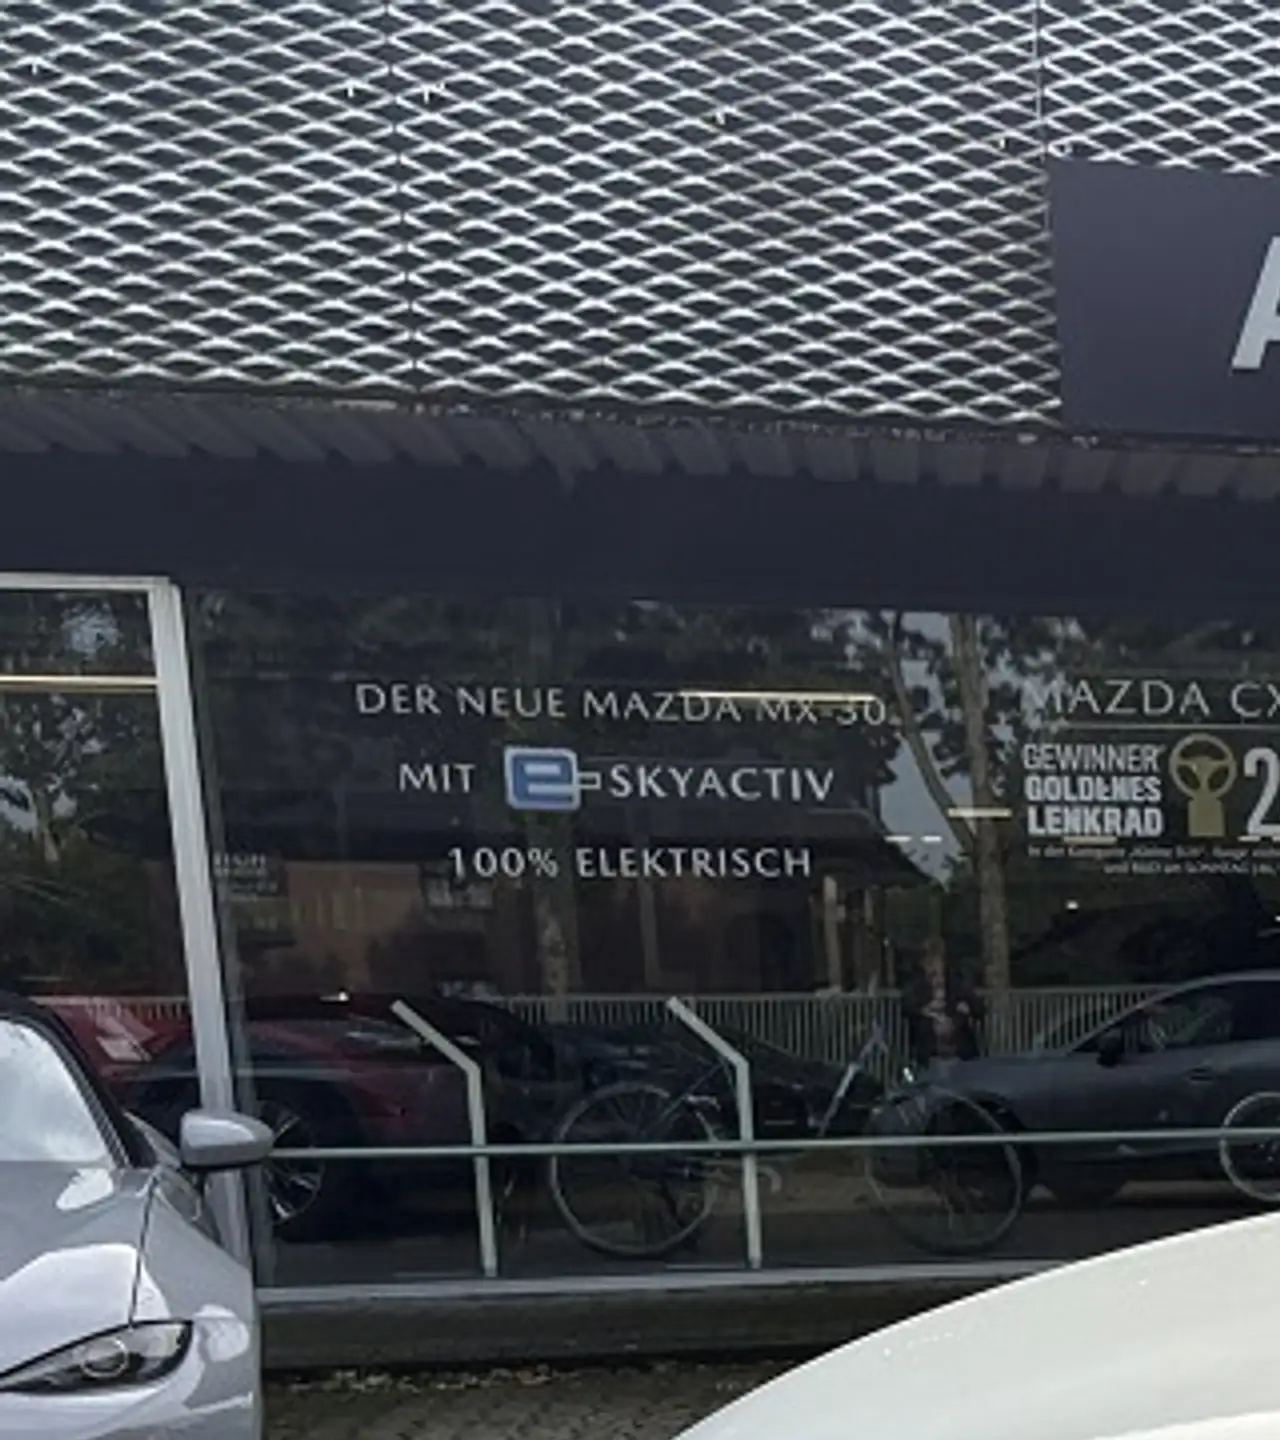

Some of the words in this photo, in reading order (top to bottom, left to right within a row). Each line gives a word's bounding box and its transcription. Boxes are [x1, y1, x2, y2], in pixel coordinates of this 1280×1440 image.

[355, 684, 441, 716] DER
[457, 686, 567, 720] NEUE
[583, 692, 743, 724] MAZDA
[1021, 678, 1210, 716] MAZDA
[399, 764, 476, 793] MIT
[1023, 774, 1163, 803] GOLDENES
[1027, 805, 1165, 838] LENKRAD
[448, 847, 559, 879] 100%
[576, 849, 812, 878] ELEKTRISCH
